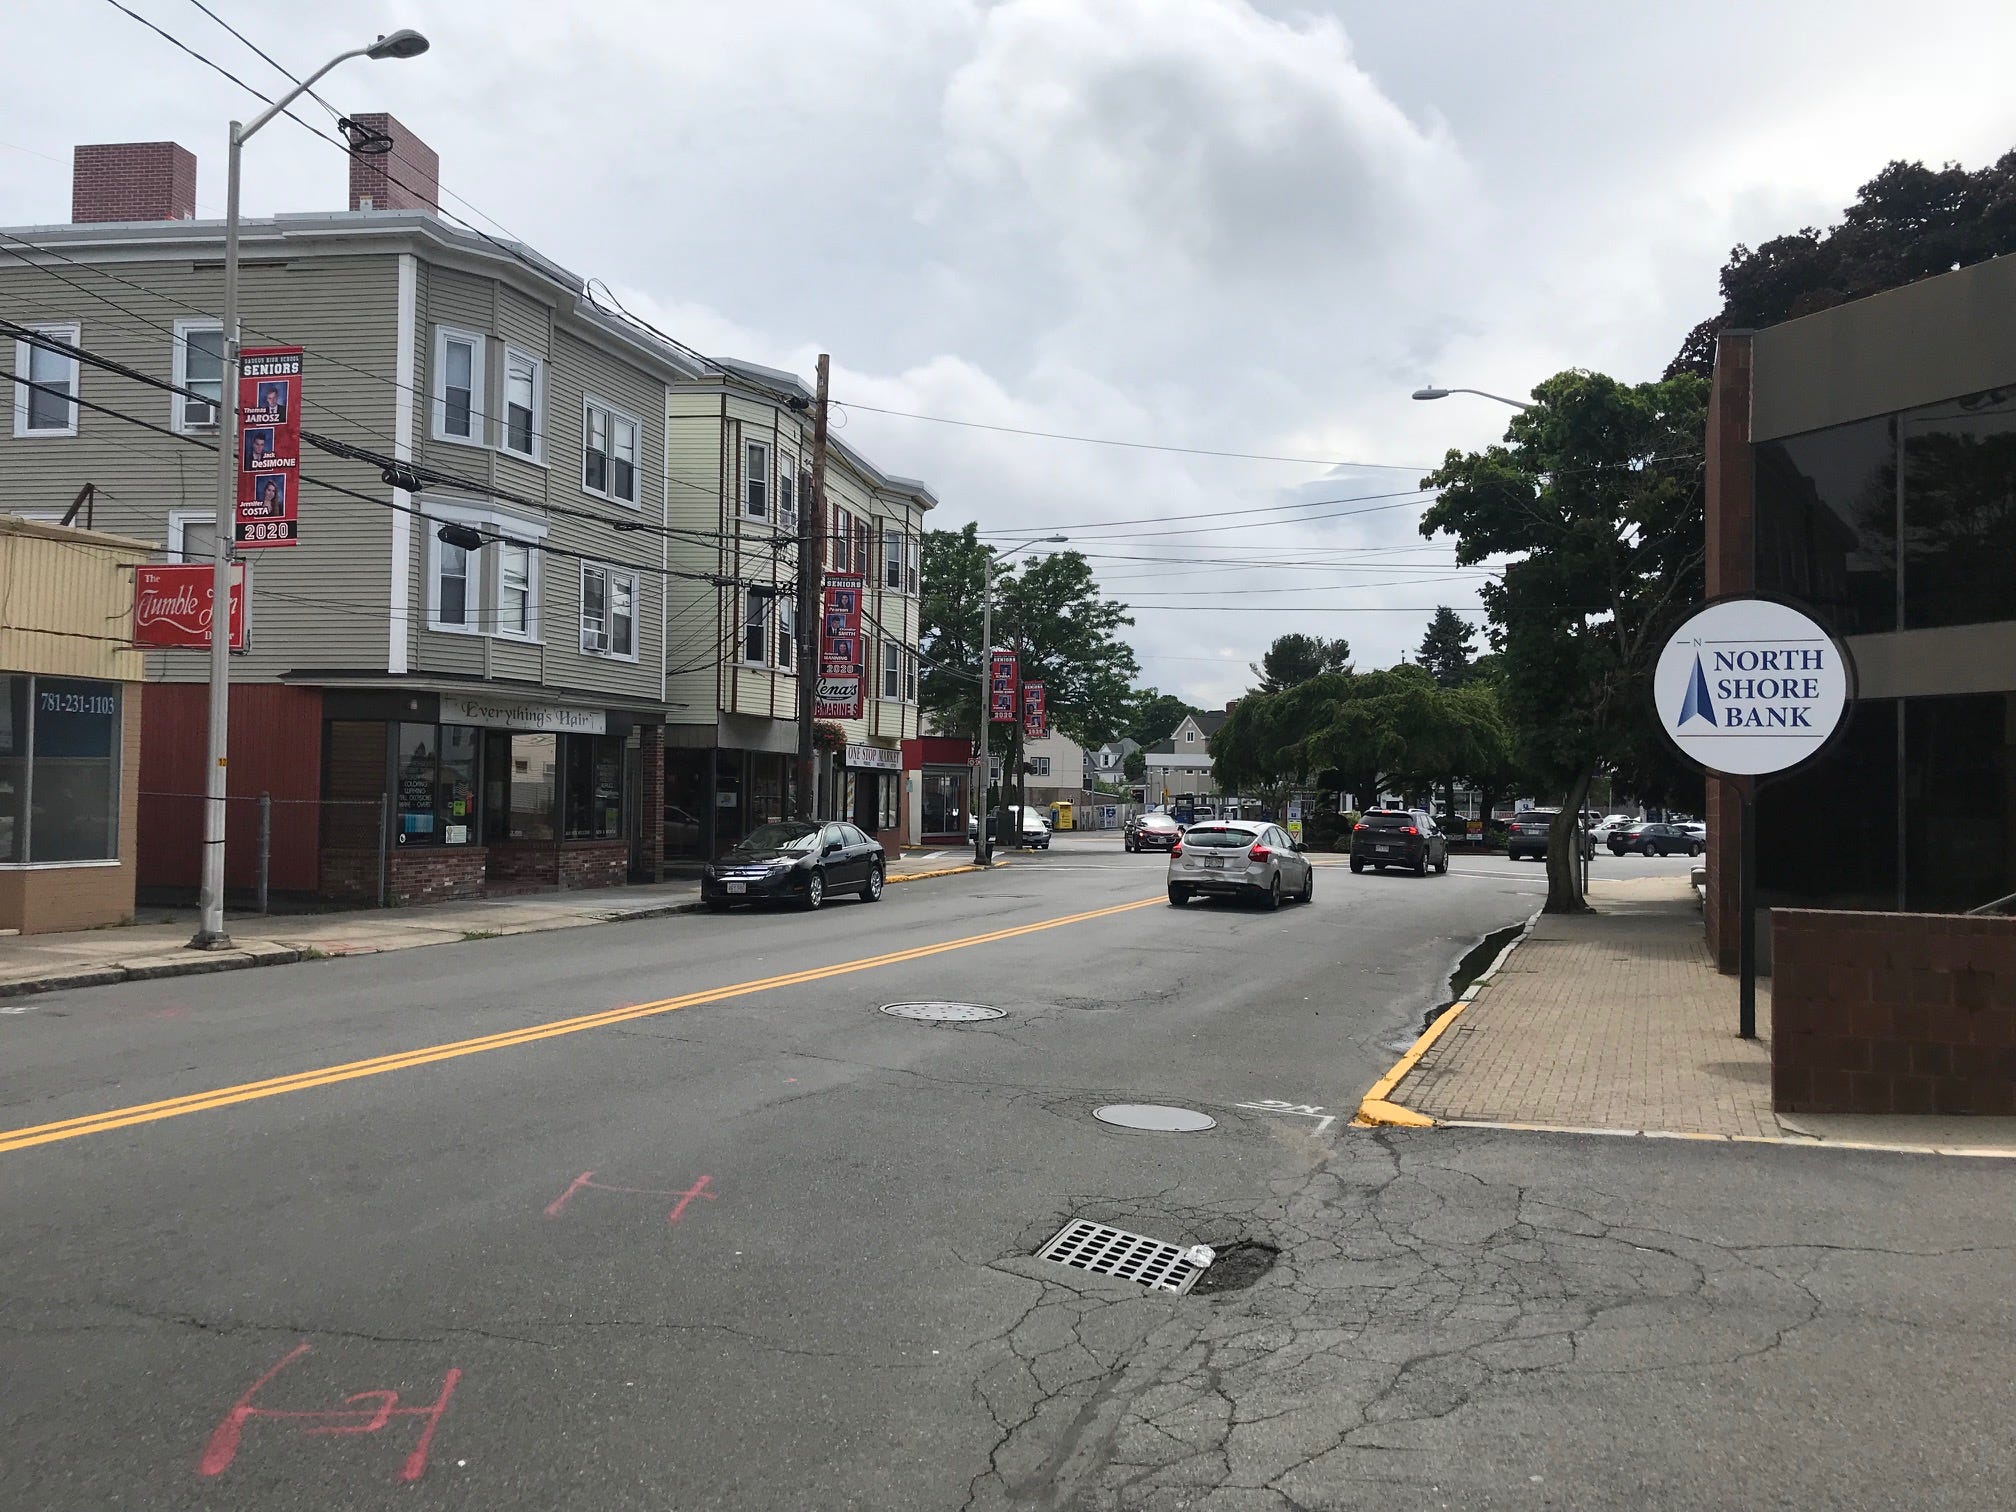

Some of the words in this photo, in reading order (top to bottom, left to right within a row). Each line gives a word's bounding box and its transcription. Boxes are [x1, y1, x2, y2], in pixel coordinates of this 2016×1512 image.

[244, 363, 299, 376] SENIORS
[245, 414, 280, 423] JAROSZ
[251, 458, 296, 468] DeSIMONE
[242, 507, 269, 515] COSTA
[244, 522, 289, 540] 2020
[144, 574, 161, 583] The
[826, 580, 861, 588] SENIORS
[138, 584, 199, 622] Tumble
[1693, 638, 1702, 647] N
[1713, 649, 1825, 672] NORTH
[826, 664, 854, 674] 2020
[1717, 678, 1820, 700] SHORE
[41, 692, 115, 715] 781-231-1103
[461, 701, 552, 728] Everything's
[1724, 706, 1813, 728] BANK
[848, 746, 860, 760] ONE
[862, 747, 877, 762] STOP
[877, 749, 900, 764] MARKET
